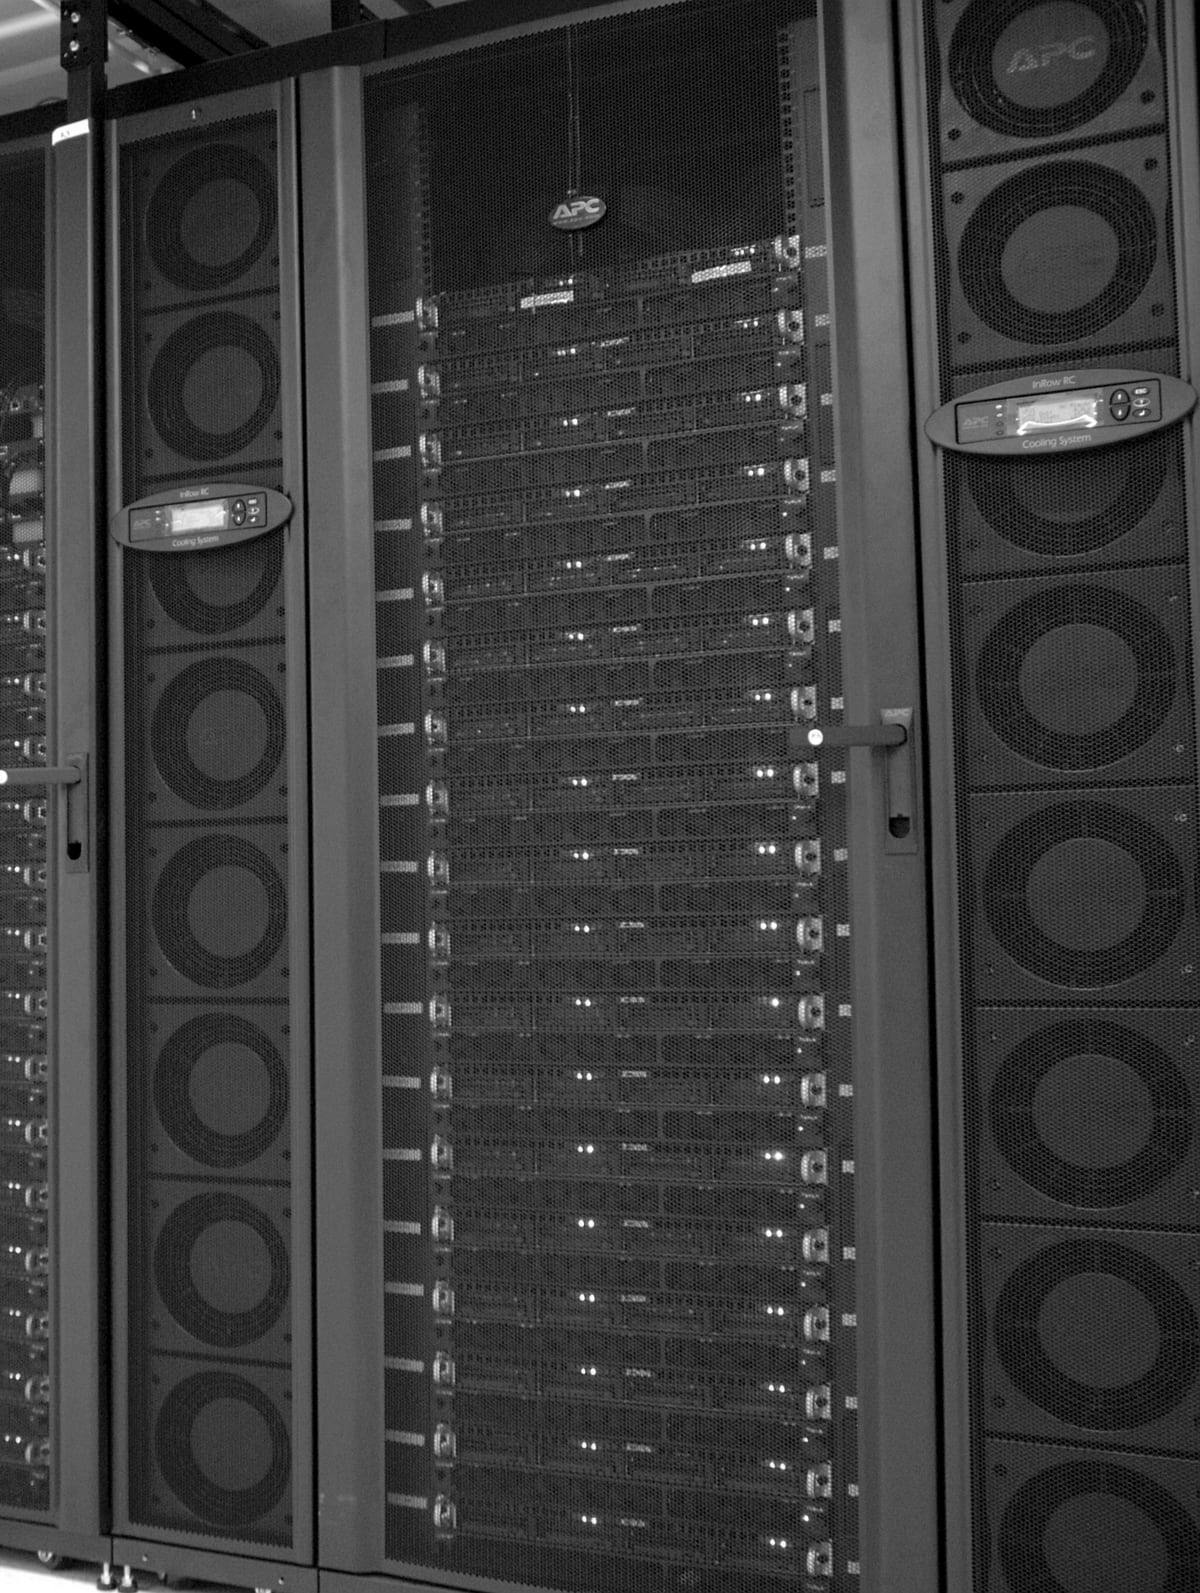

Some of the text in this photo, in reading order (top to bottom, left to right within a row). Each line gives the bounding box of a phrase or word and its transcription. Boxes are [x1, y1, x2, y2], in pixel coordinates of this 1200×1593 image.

[1006, 35, 1097, 74] APC
[552, 198, 600, 219] APC
[1032, 375, 1076, 389] InRow RC
[1022, 433, 1092, 449] Cooling System
